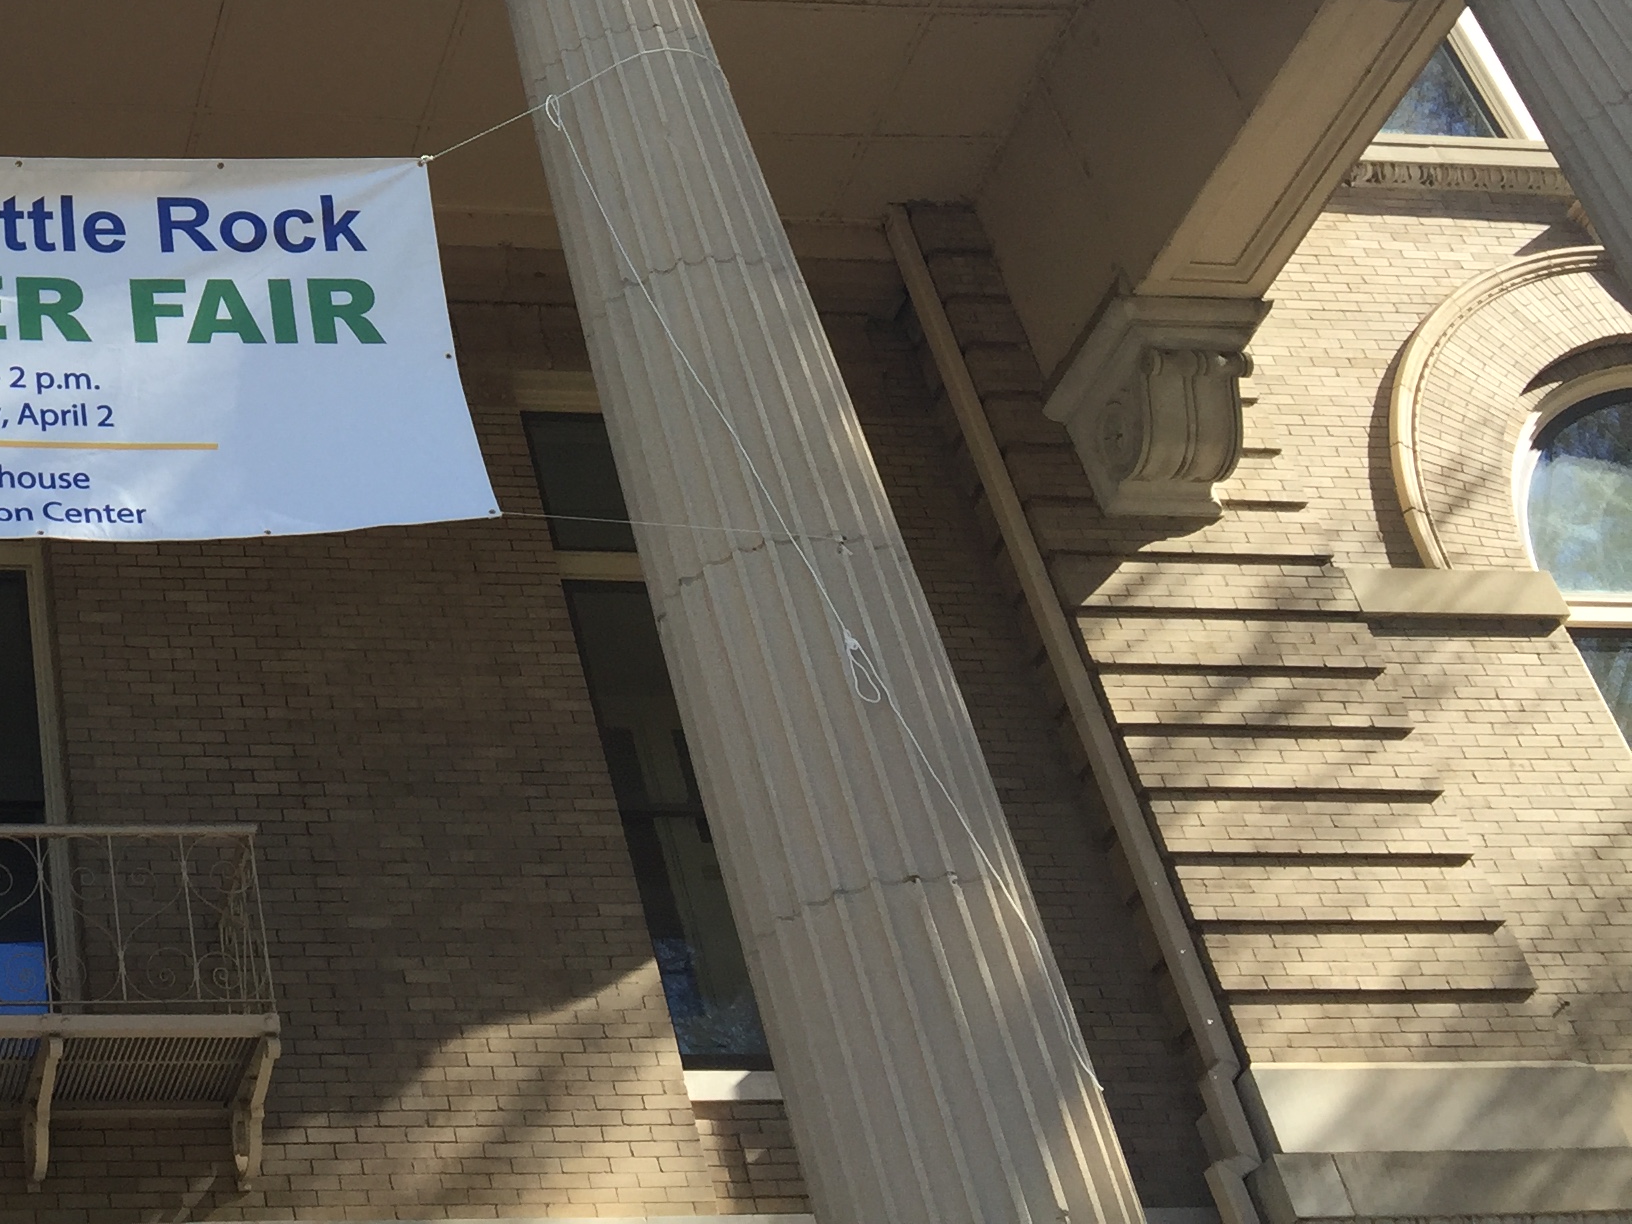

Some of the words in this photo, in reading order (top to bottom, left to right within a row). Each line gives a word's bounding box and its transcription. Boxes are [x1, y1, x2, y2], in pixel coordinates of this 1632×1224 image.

[157, 195, 367, 253] Rock
[129, 278, 387, 344] FAIR
[10, 366, 26, 388] 2
[36, 372, 100, 394] p.m.
[18, 403, 87, 431] April
[97, 405, 114, 427] 2
[43, 502, 146, 524] Center
